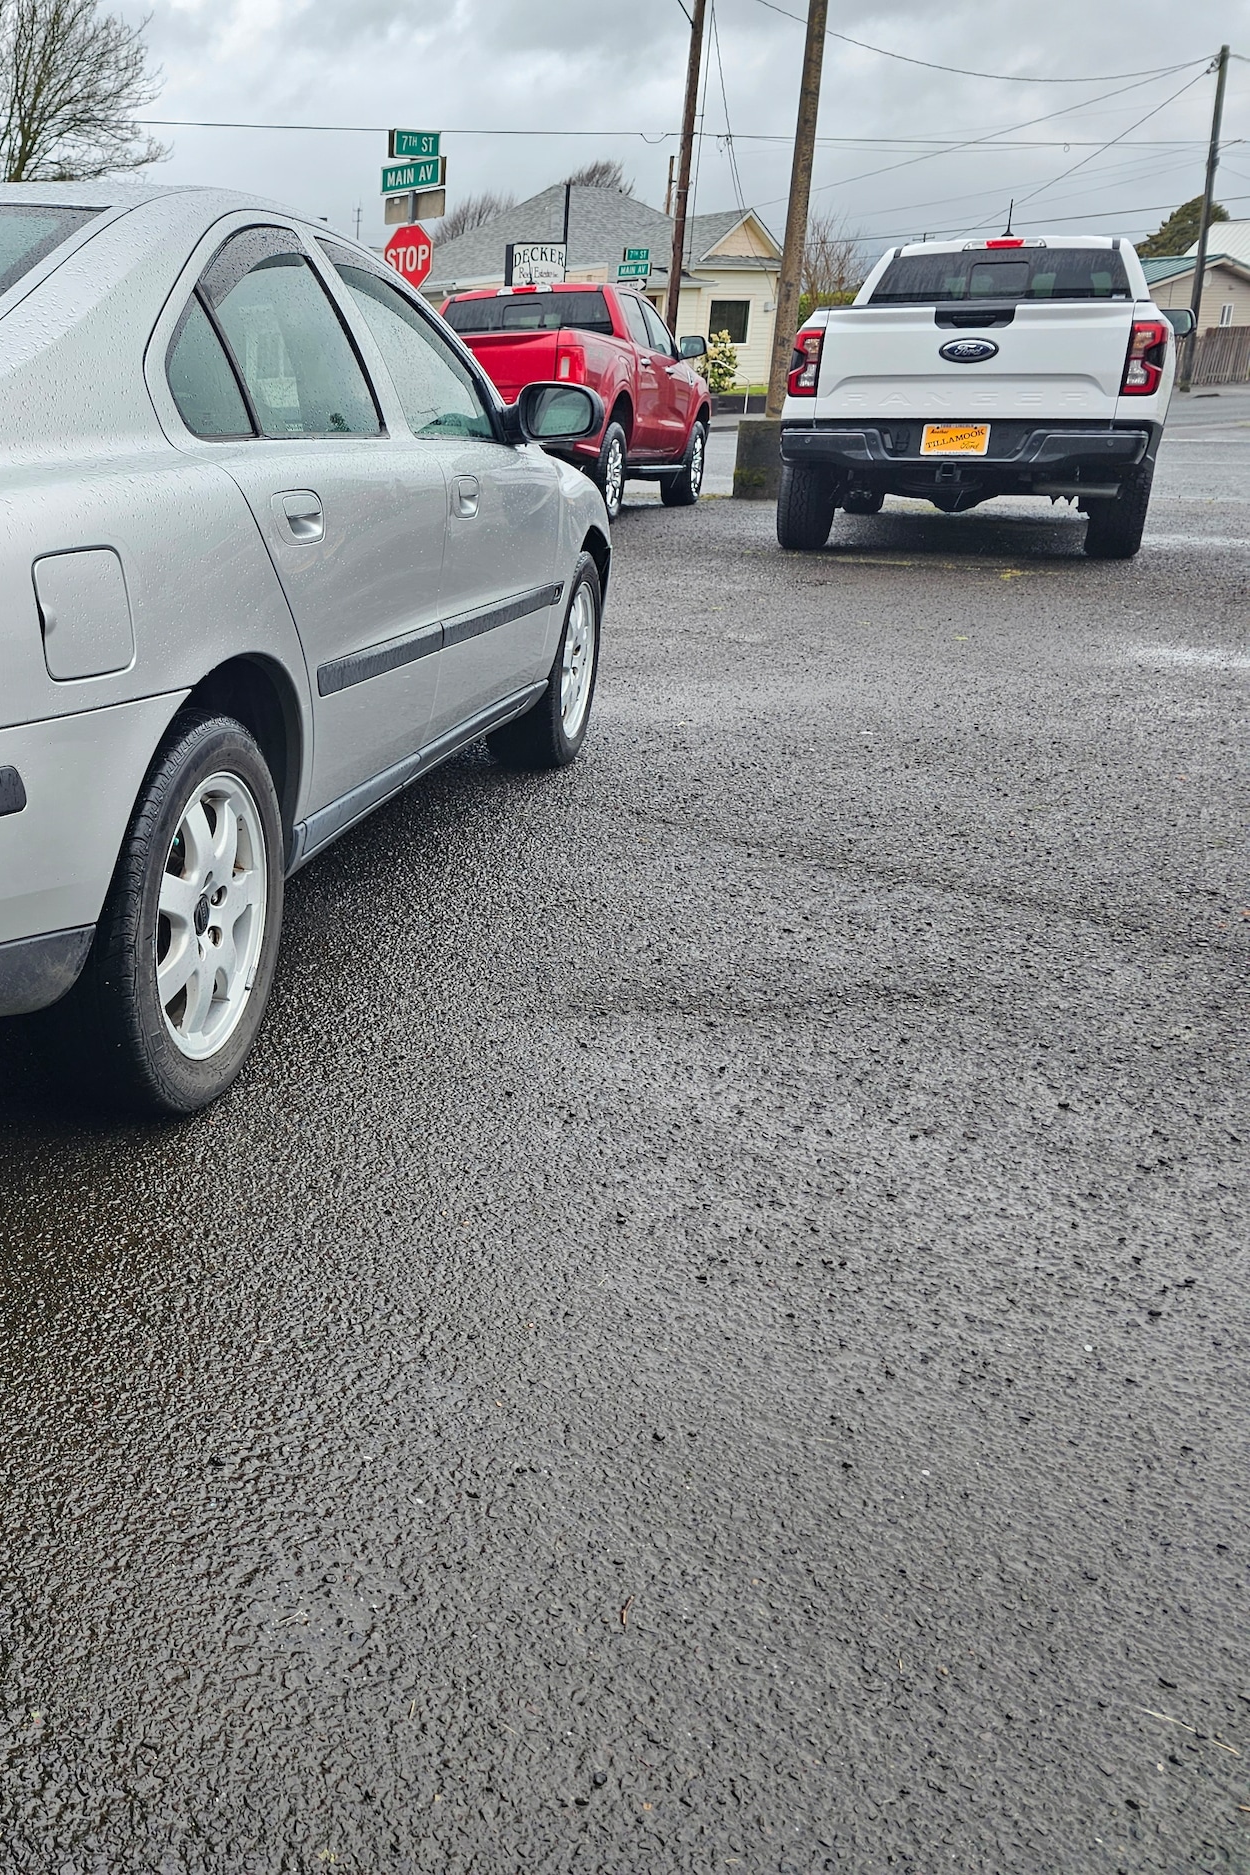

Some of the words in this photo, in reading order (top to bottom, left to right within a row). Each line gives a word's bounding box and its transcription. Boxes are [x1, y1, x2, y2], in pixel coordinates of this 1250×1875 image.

[402, 135, 418, 151] 7TH
[421, 136, 434, 153] ST
[387, 167, 415, 188] MAIN
[418, 163, 434, 182] AV
[386, 244, 430, 273] STOP
[514, 246, 565, 267] DECKER
[639, 250, 647, 259] ST
[620, 265, 636, 275] MAIN
[637, 264, 647, 274] AV
[926, 428, 985, 449] TILLAMOOK
